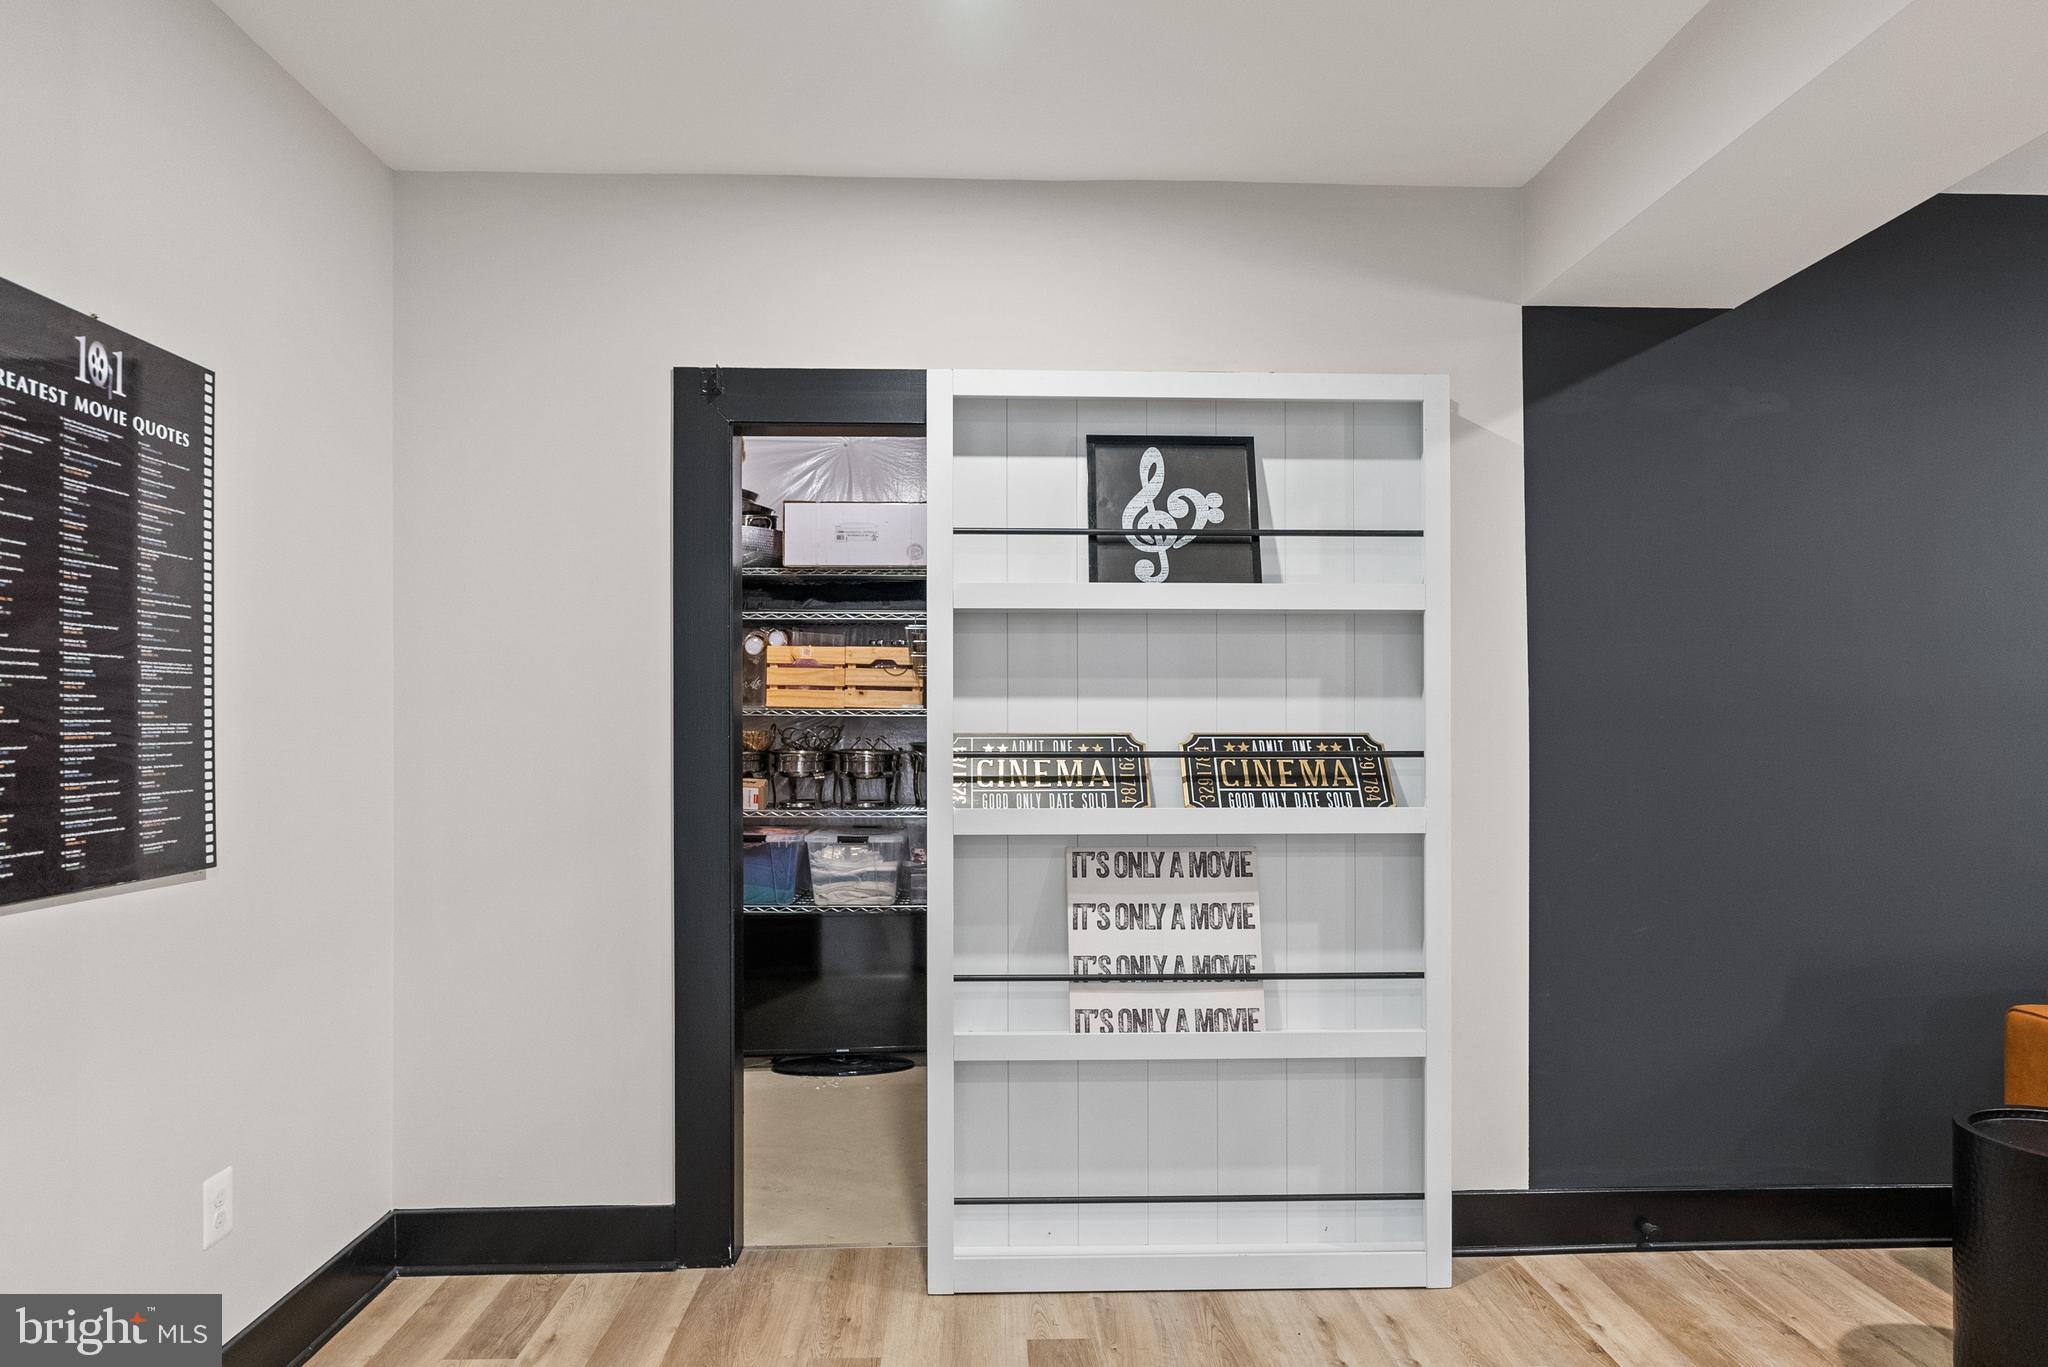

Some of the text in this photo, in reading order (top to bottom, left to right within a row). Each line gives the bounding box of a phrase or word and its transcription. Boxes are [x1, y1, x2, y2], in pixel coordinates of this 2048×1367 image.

[74, 395, 128, 428] MOVIE
[132, 416, 190, 448] QUOTES
[976, 759, 1110, 788] CINEMA
[1220, 758, 1354, 787] CINEMA
[982, 792, 1108, 808] GOOD ONLY DATE SOLD
[1228, 791, 1353, 808] GOOD ONLY DATE SOLD
[1071, 851, 1254, 879] IT'S ONLY A MOVIE
[1072, 902, 1256, 931] IT'S ONLY A MOVIE
[1073, 955, 1259, 983] IT'S ONLY A MOVIE
[1074, 1008, 1260, 1033] IT'S ONLY A MOVIE
